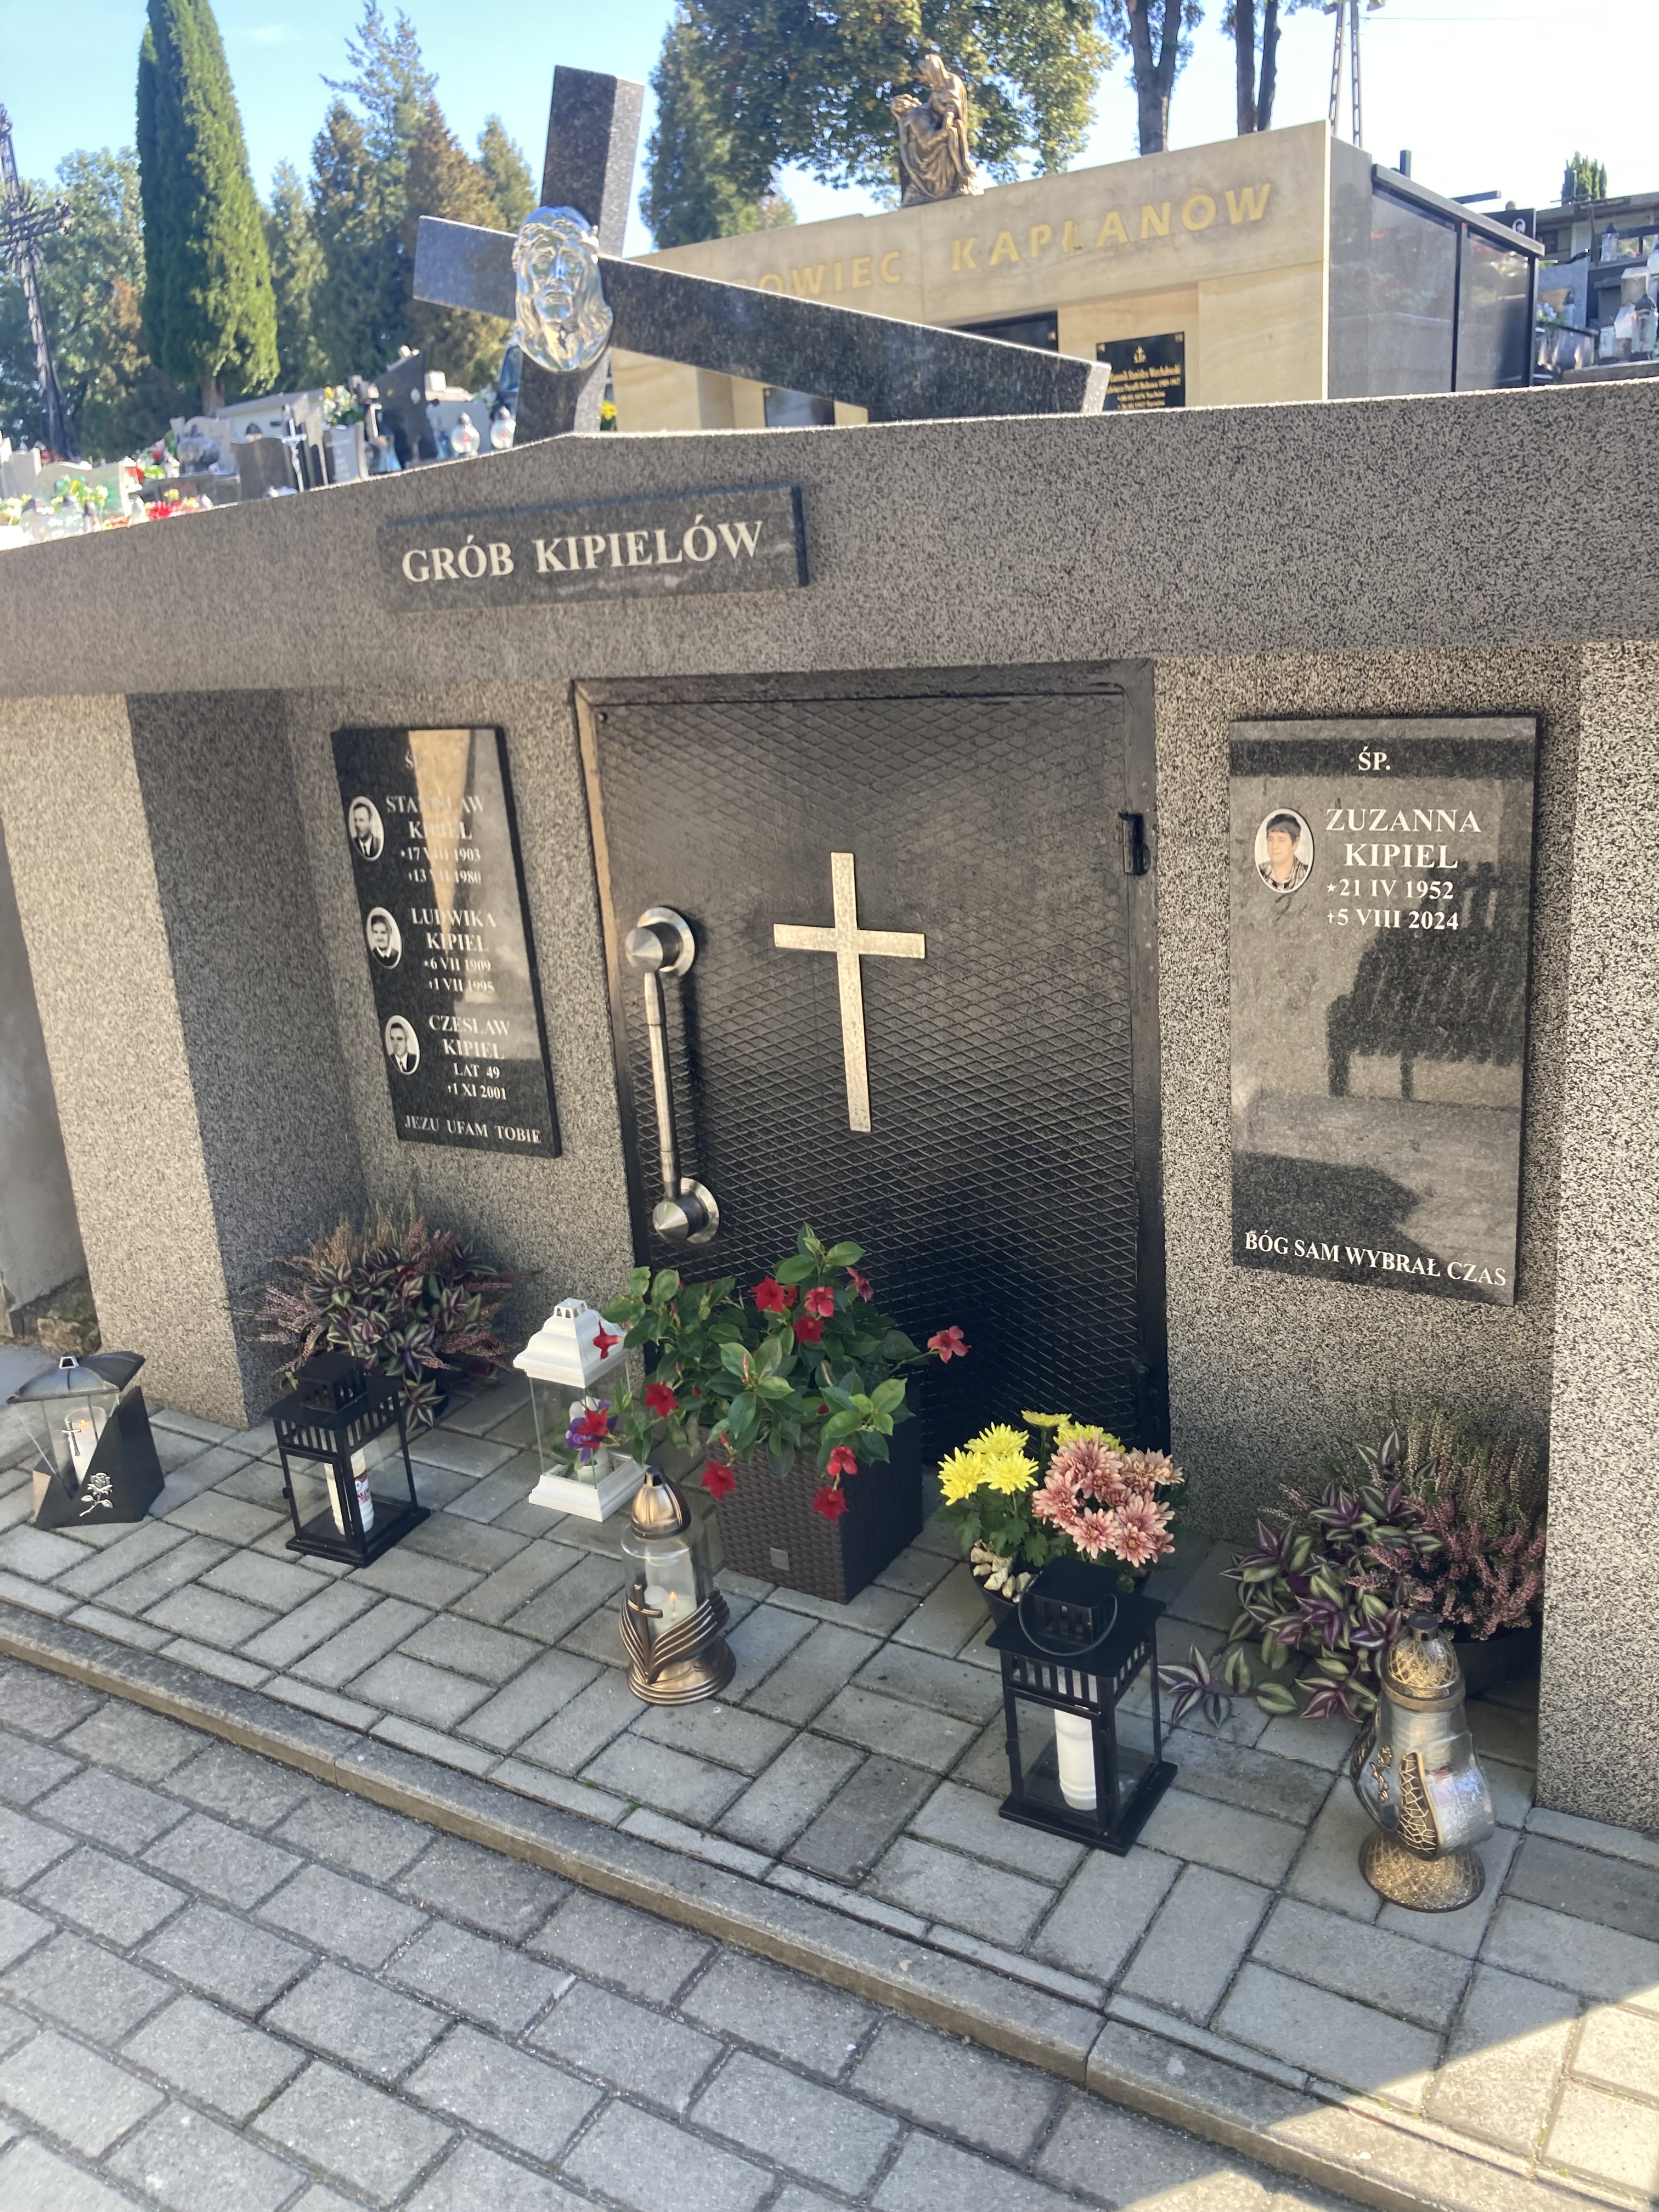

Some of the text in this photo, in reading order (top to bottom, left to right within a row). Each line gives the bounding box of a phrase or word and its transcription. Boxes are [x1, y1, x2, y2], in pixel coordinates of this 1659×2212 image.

[729, 251, 900, 297] OWIEC
[402, 514, 763, 583] GRÓB KIPIELÓW
[1358, 746, 1391, 771] ŚP.
[1325, 809, 1481, 833] ZUZANNA
[454, 848, 481, 862] 1903
[1344, 843, 1459, 869] KIPIEL
[454, 870, 482, 884] 1980
[1339, 879, 1454, 900] 21 IV 1952
[411, 907, 496, 928] LUDWIKA
[1356, 909, 1401, 928] VIII
[1408, 910, 1459, 930] 2024
[426, 932, 489, 952] KIPIEL
[440, 957, 460, 971] VII
[465, 958, 491, 972] 1909
[443, 977, 464, 992] VII
[467, 980, 495, 994] 1995
[443, 1038, 505, 1059] KIPIEL
[453, 1062, 500, 1079] LAT 49
[462, 1083, 477, 1097] XI
[479, 1085, 506, 1100] 2001
[405, 1115, 541, 1144] JEZU UFAM TOBIE
[1245, 1230, 1506, 1286] BÓG SAM WYBRAŁ CZAS
